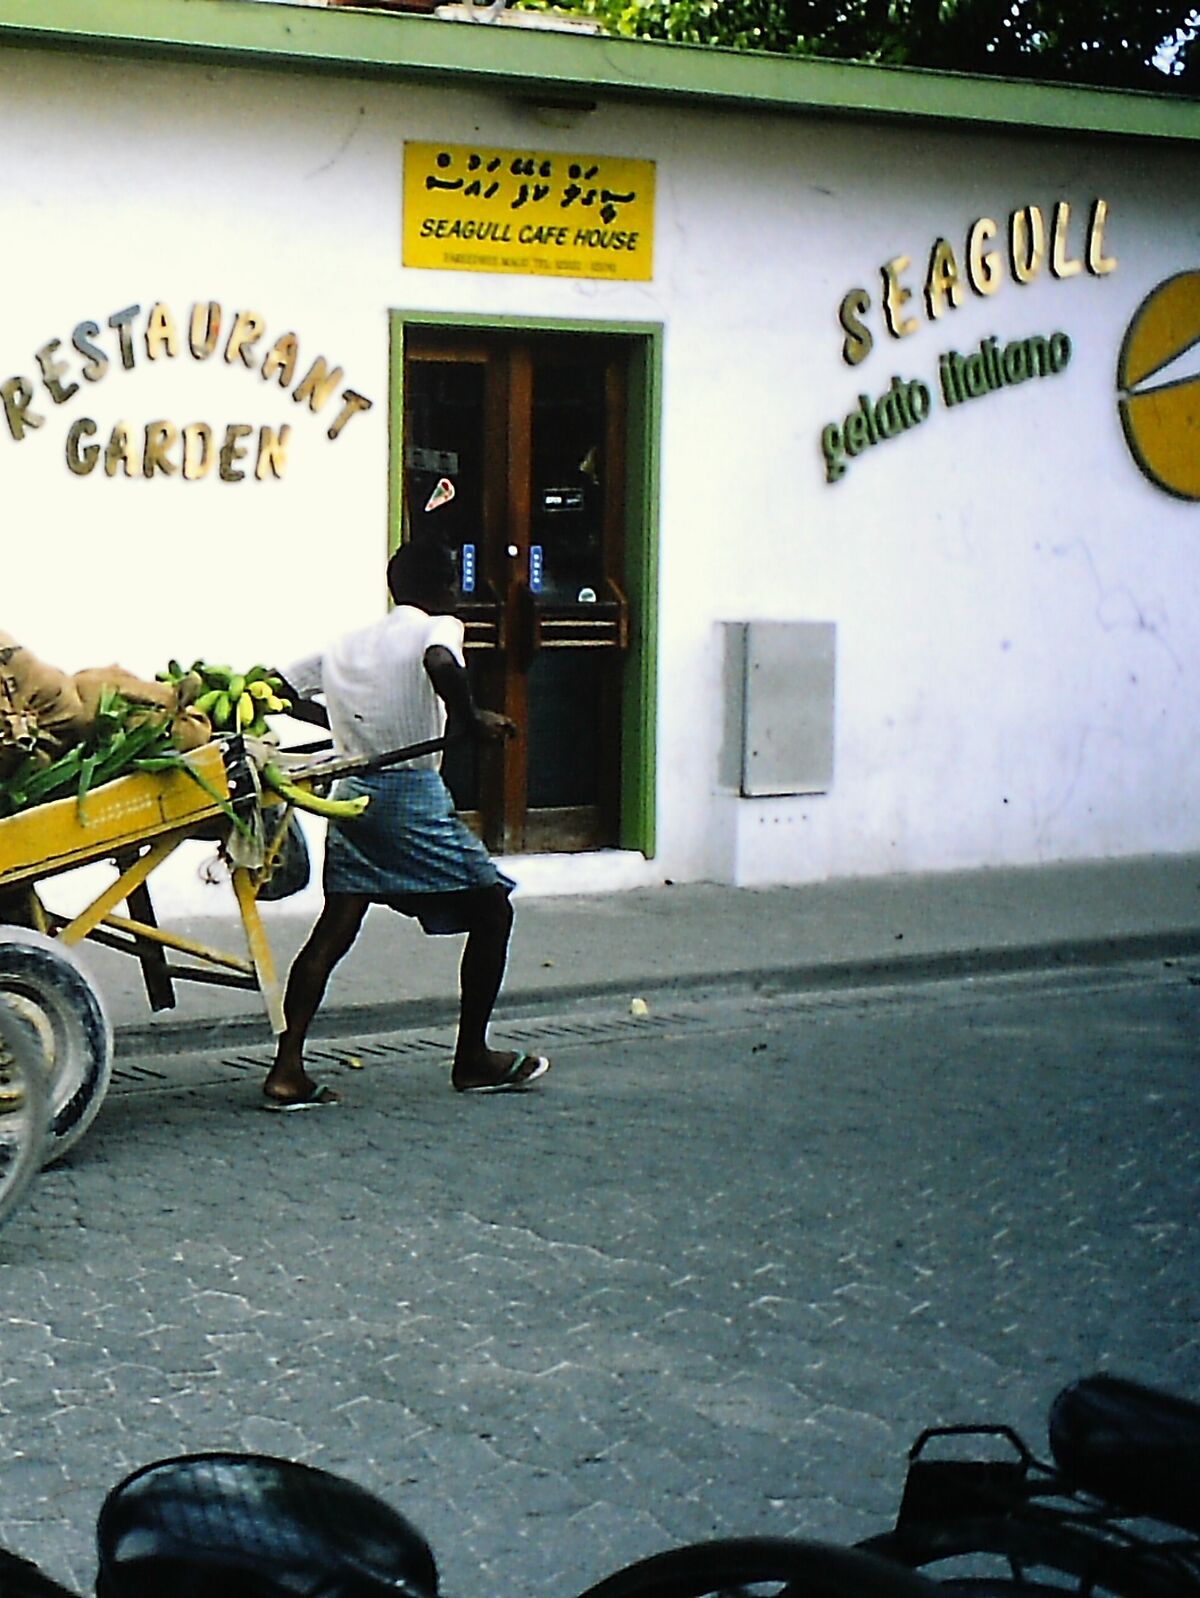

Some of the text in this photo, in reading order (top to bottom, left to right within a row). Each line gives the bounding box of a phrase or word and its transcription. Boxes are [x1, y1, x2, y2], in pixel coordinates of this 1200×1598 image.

[420, 218, 639, 251] SEAGULL CAFE HOUSE
[838, 199, 1117, 366] SEAGULL
[0, 301, 372, 441] RESTAURANT
[821, 332, 1072, 484] gelato italiano
[66, 417, 290, 482] GARDEN
